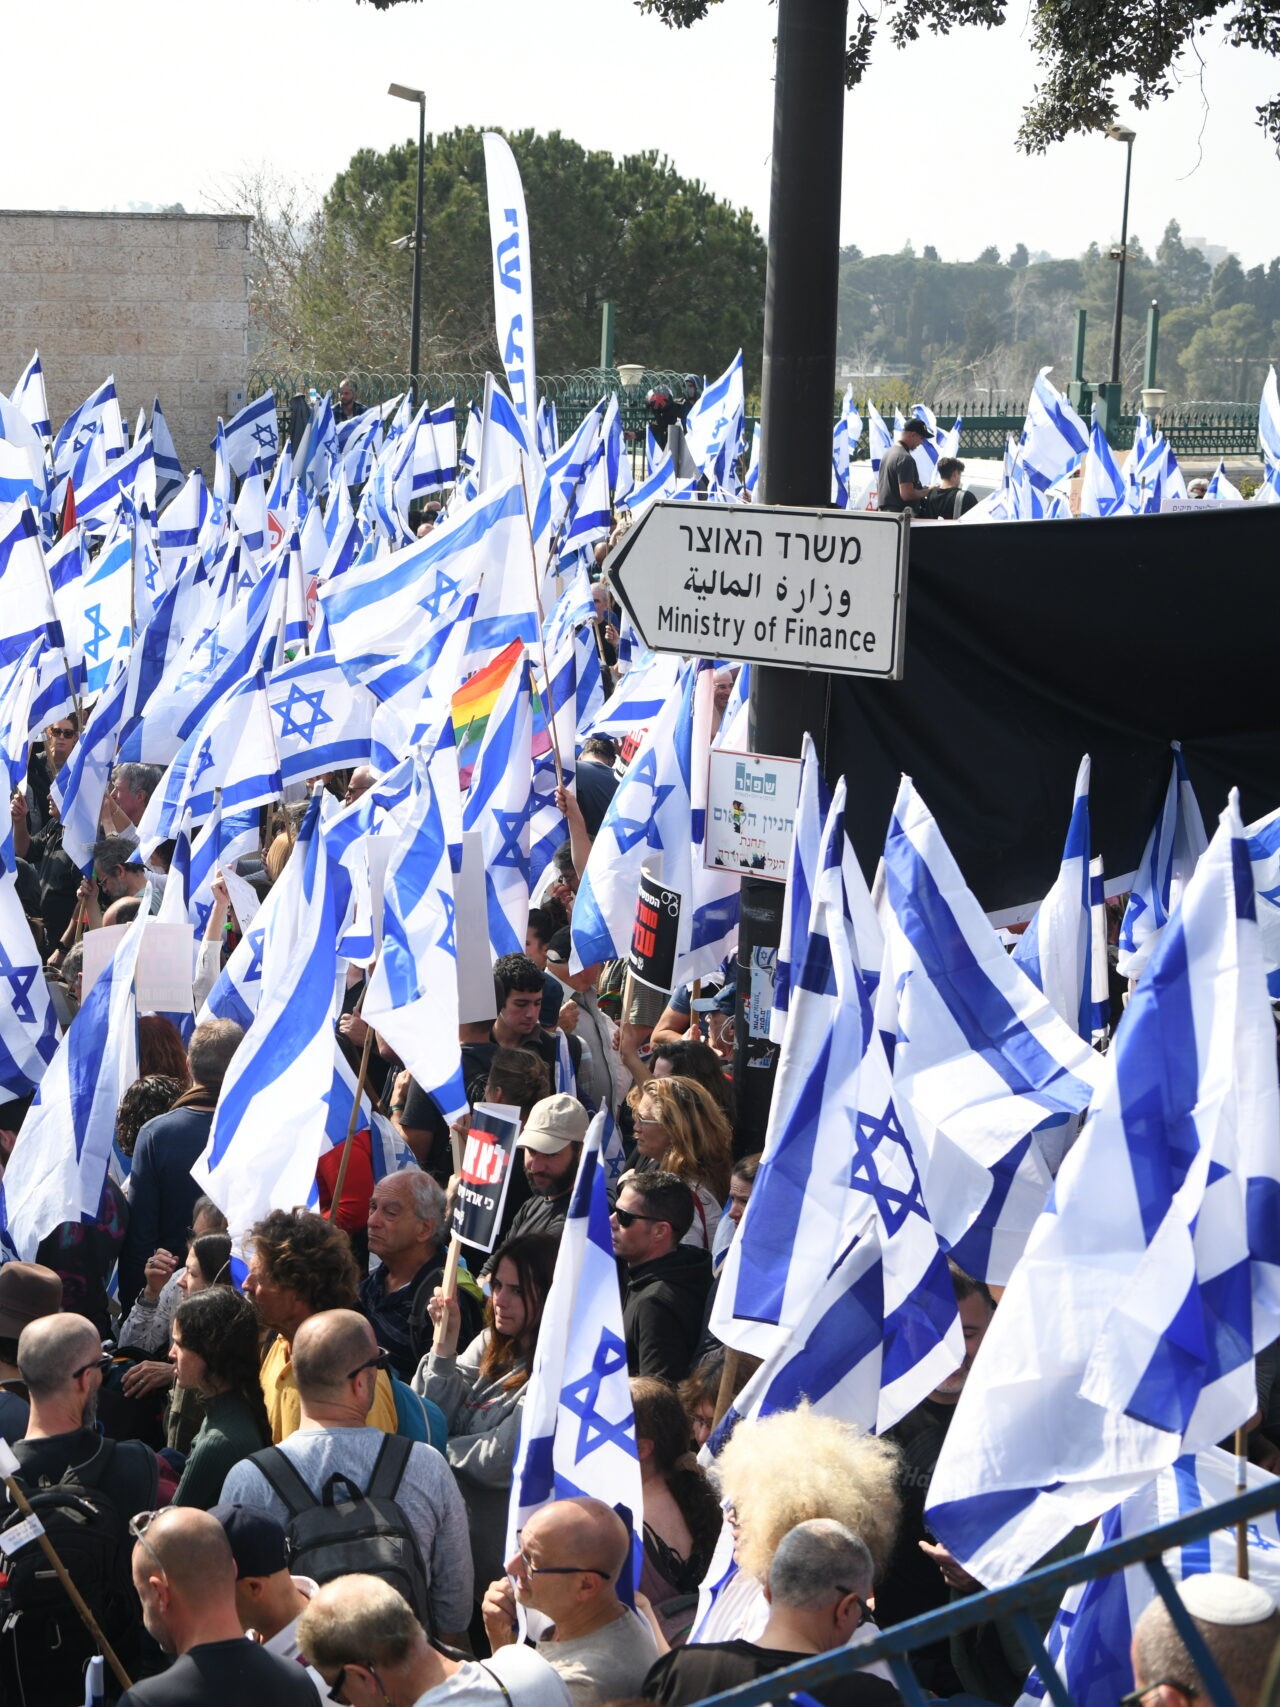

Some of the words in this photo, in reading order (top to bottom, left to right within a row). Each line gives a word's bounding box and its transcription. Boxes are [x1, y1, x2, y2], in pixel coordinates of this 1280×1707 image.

[679, 525, 762, 557] האוצר
[775, 531, 862, 565] משרד
[683, 567, 761, 600] المالية
[776, 575, 851, 618] وزارة
[657, 605, 745, 646] Ministry
[754, 616, 777, 643] of
[785, 617, 876, 653] Finance
[735, 771, 776, 795] שפיר
[763, 815, 793, 834] חניון
[902, 1465, 931, 1488] Ha
